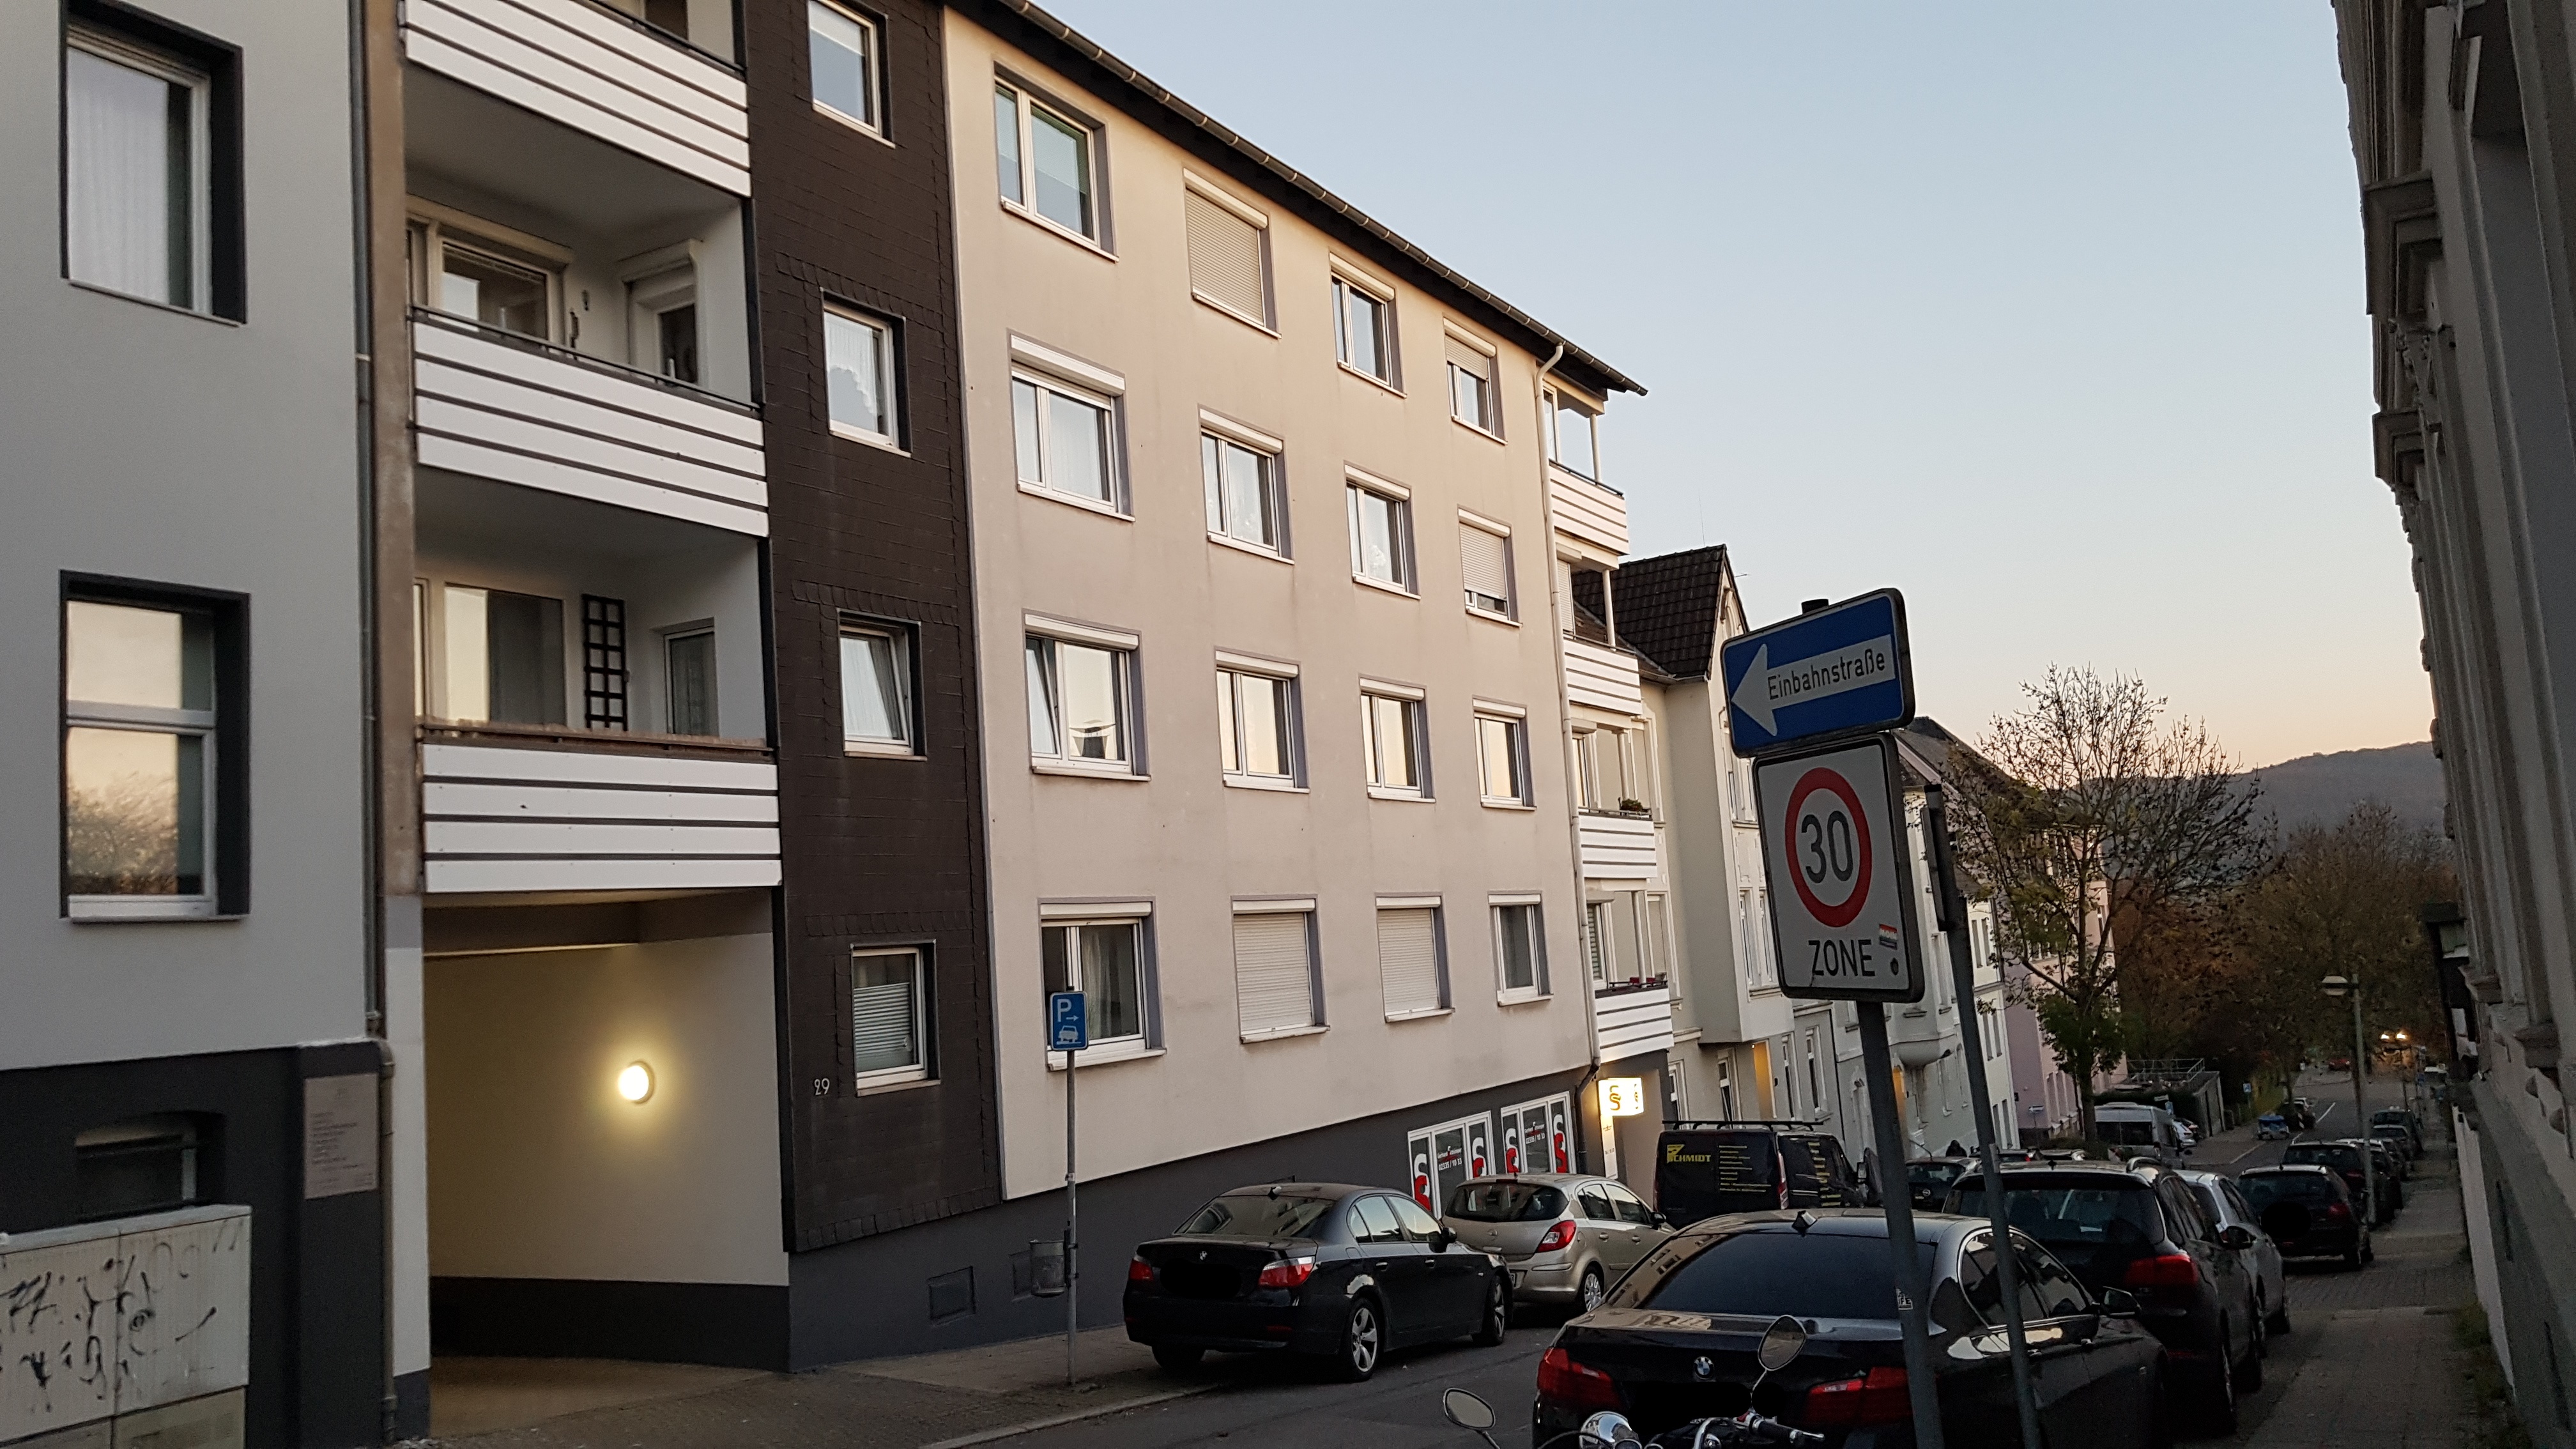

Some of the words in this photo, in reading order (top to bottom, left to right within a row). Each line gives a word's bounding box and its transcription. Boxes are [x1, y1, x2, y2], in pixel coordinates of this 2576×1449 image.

[1767, 648, 1885, 700] Einbahnstraße
[1801, 810, 1853, 884] 30
[1808, 939, 1876, 977] ZONE
[1057, 999, 1072, 1022] P
[814, 1078, 830, 1095] 29
